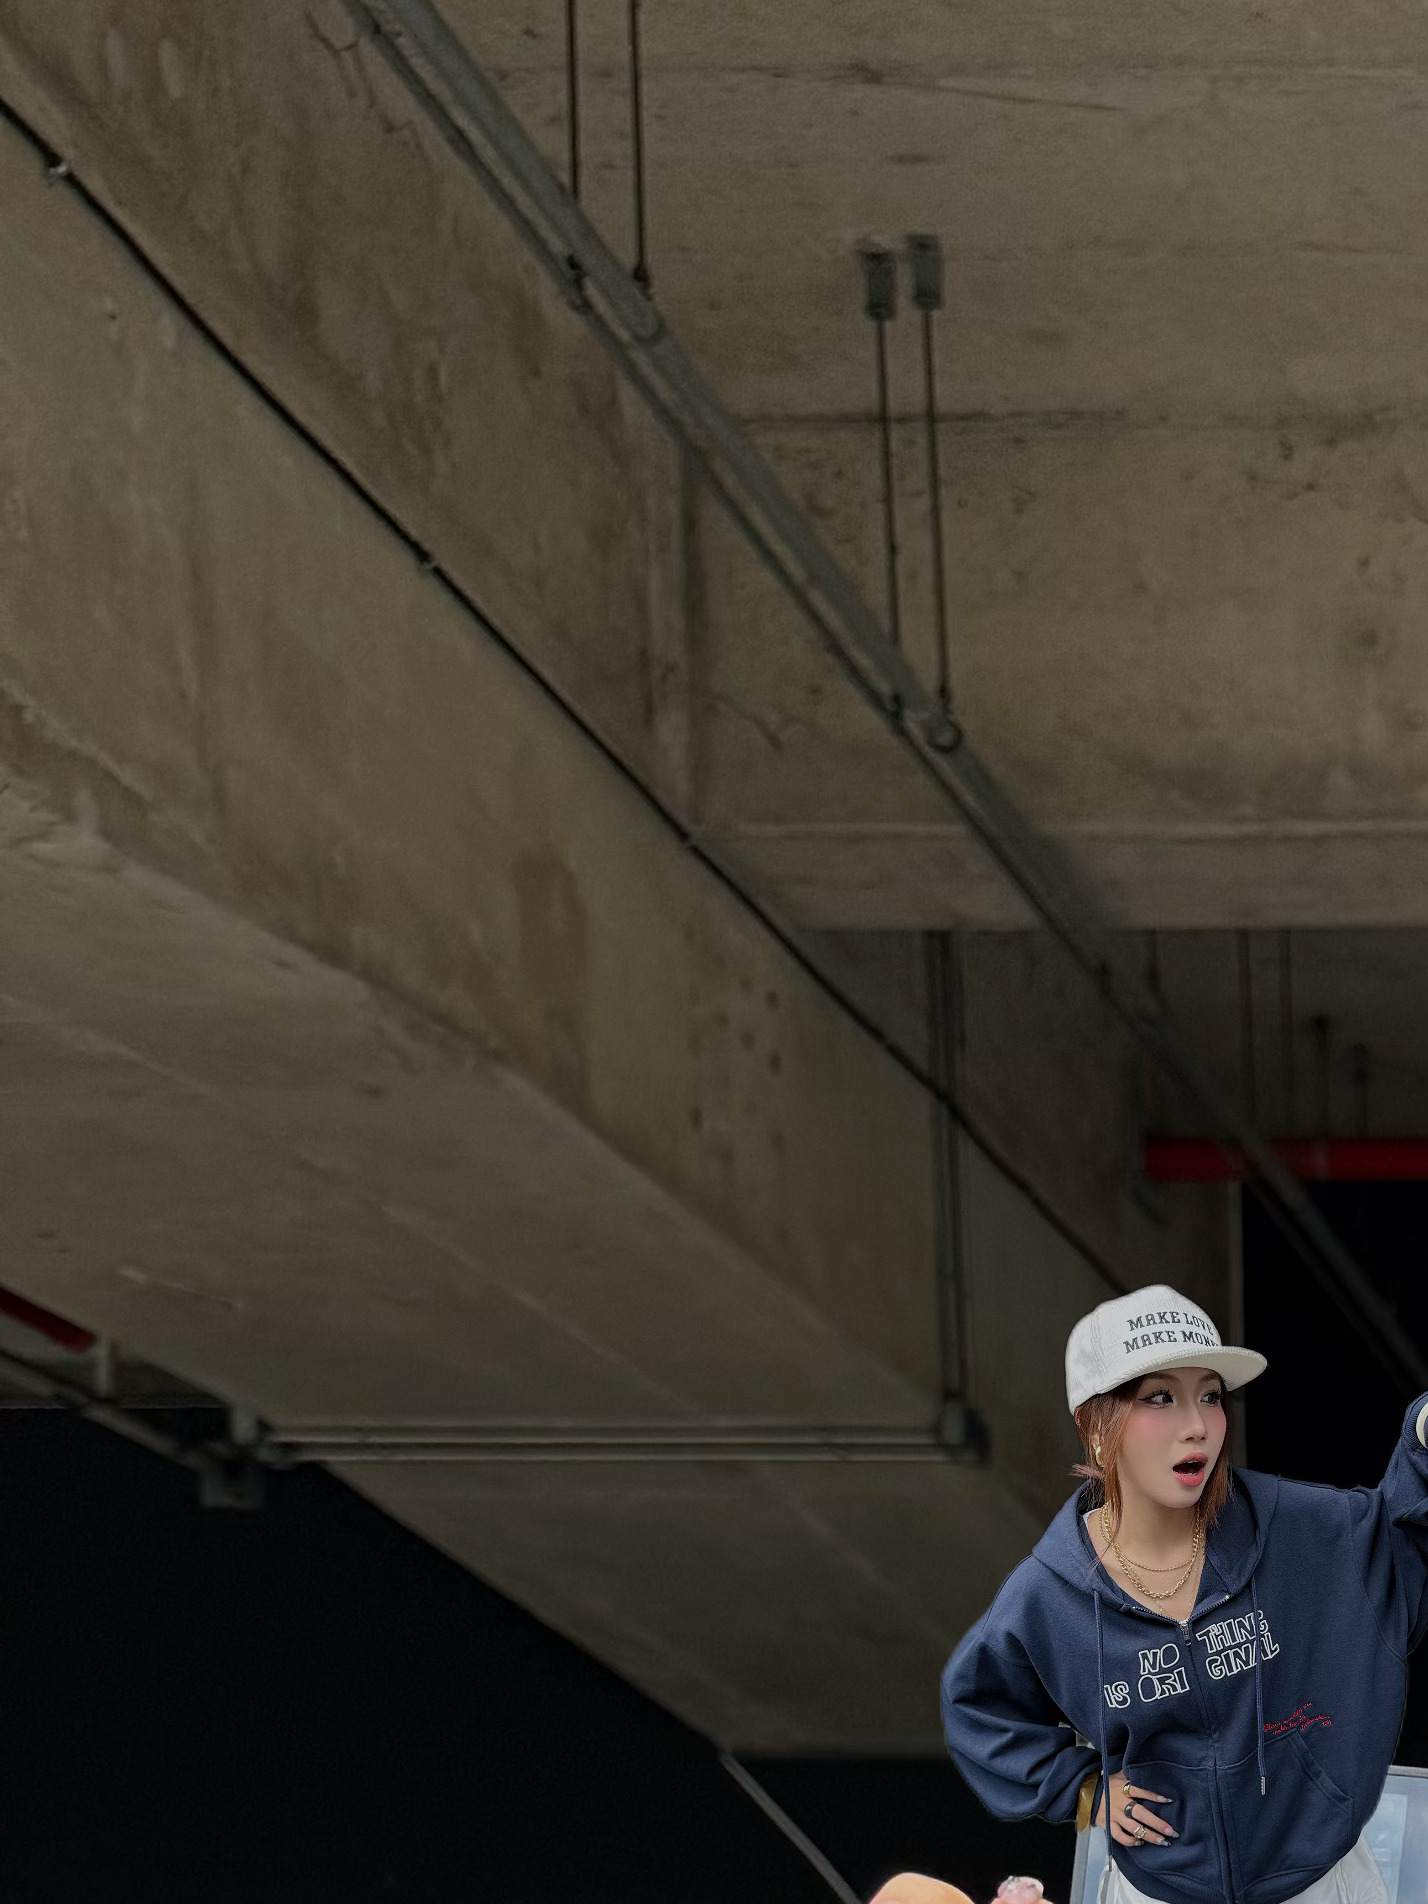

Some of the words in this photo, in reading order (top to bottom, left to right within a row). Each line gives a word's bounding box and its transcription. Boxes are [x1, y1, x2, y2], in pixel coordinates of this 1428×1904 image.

[1127, 1311, 1180, 1332] MAKE
[1123, 1330, 1177, 1354] MAKE
[1139, 1643, 1180, 1675] NO
[1104, 1681, 1131, 1708] IS
[1138, 1667, 1190, 1703] ORI
